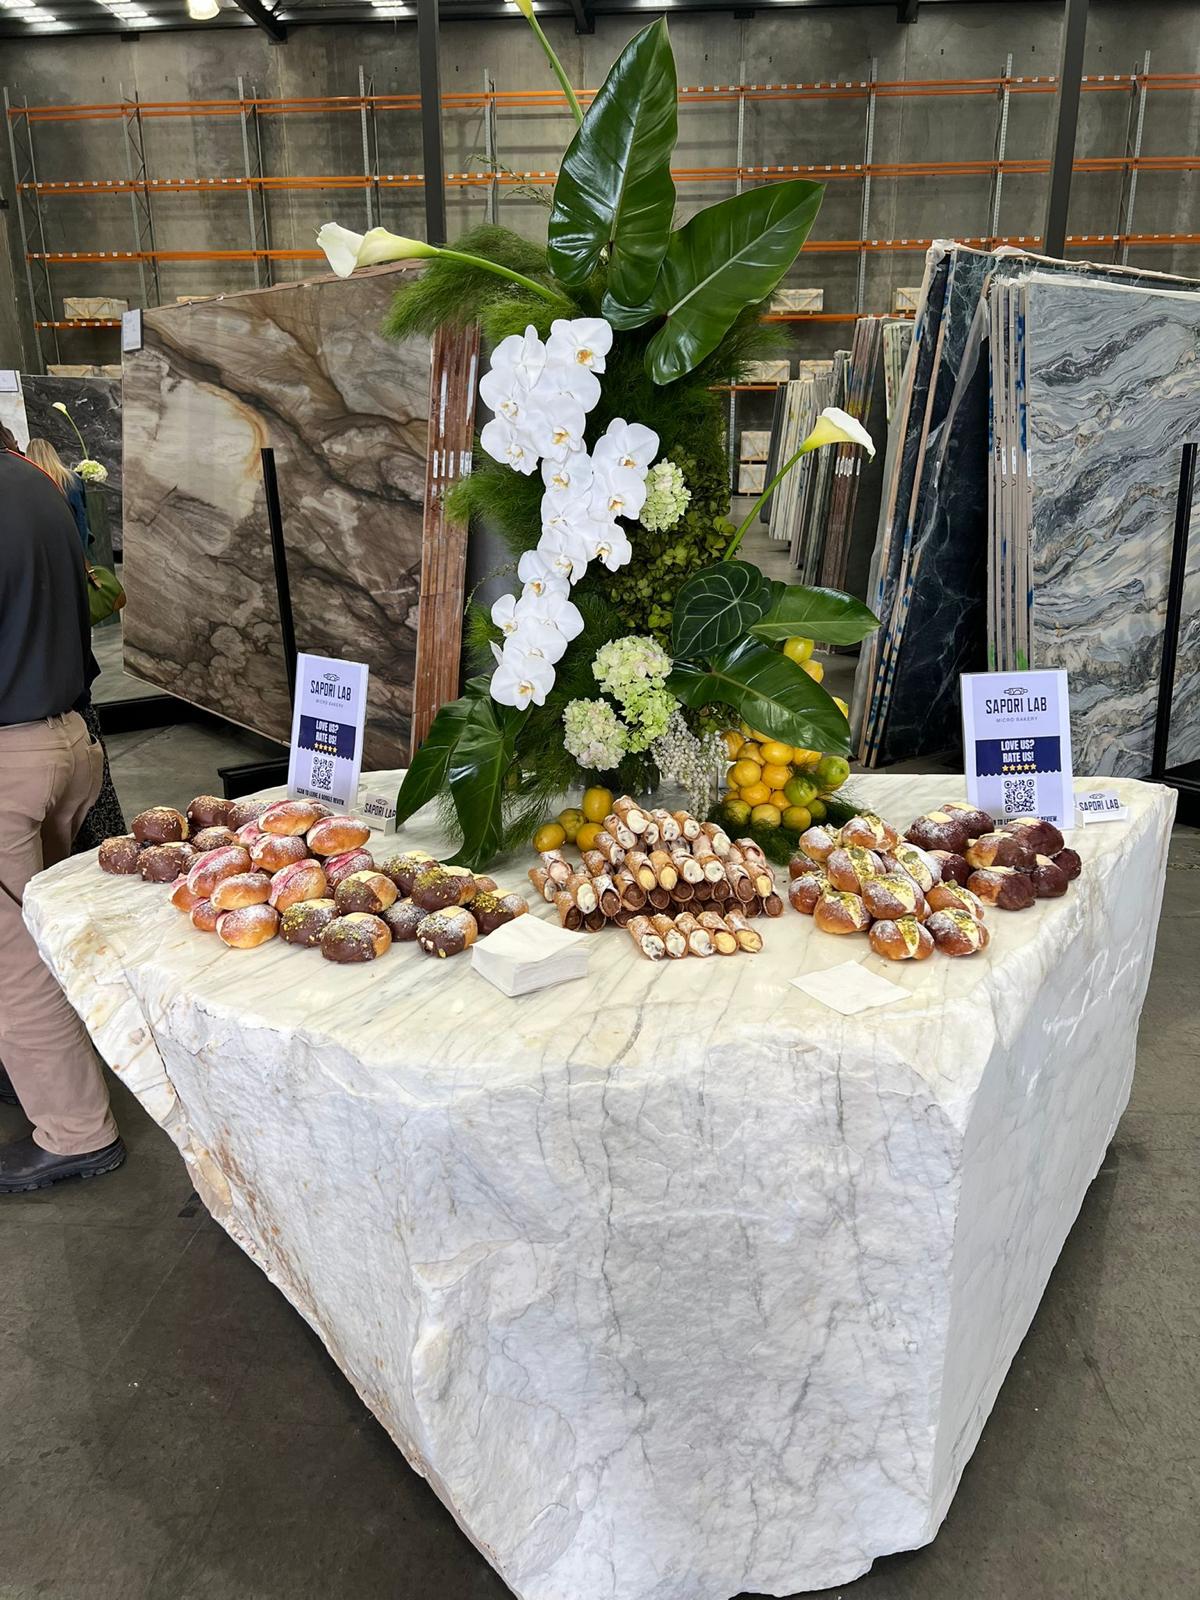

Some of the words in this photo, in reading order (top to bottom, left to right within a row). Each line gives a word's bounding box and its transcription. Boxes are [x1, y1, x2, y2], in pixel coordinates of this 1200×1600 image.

[310, 680, 336, 698] SAPORI
[338, 685, 352, 701] LAB
[986, 699, 1024, 714] SAPORI
[1028, 697, 1047, 712] LAB
[315, 720, 328, 732] LOVE
[328, 722, 339, 734] US?
[315, 731, 328, 743] RATE
[328, 734, 338, 745] US!
[1001, 740, 1020, 751] LOVE
[1020, 739, 1035, 750] US?
[1003, 752, 1021, 763] RATE
[1022, 751, 1035, 762] US!
[364, 803, 385, 817] SAPORI
[1079, 800, 1105, 811] SAPORI
[1105, 798, 1120, 810] LAB
